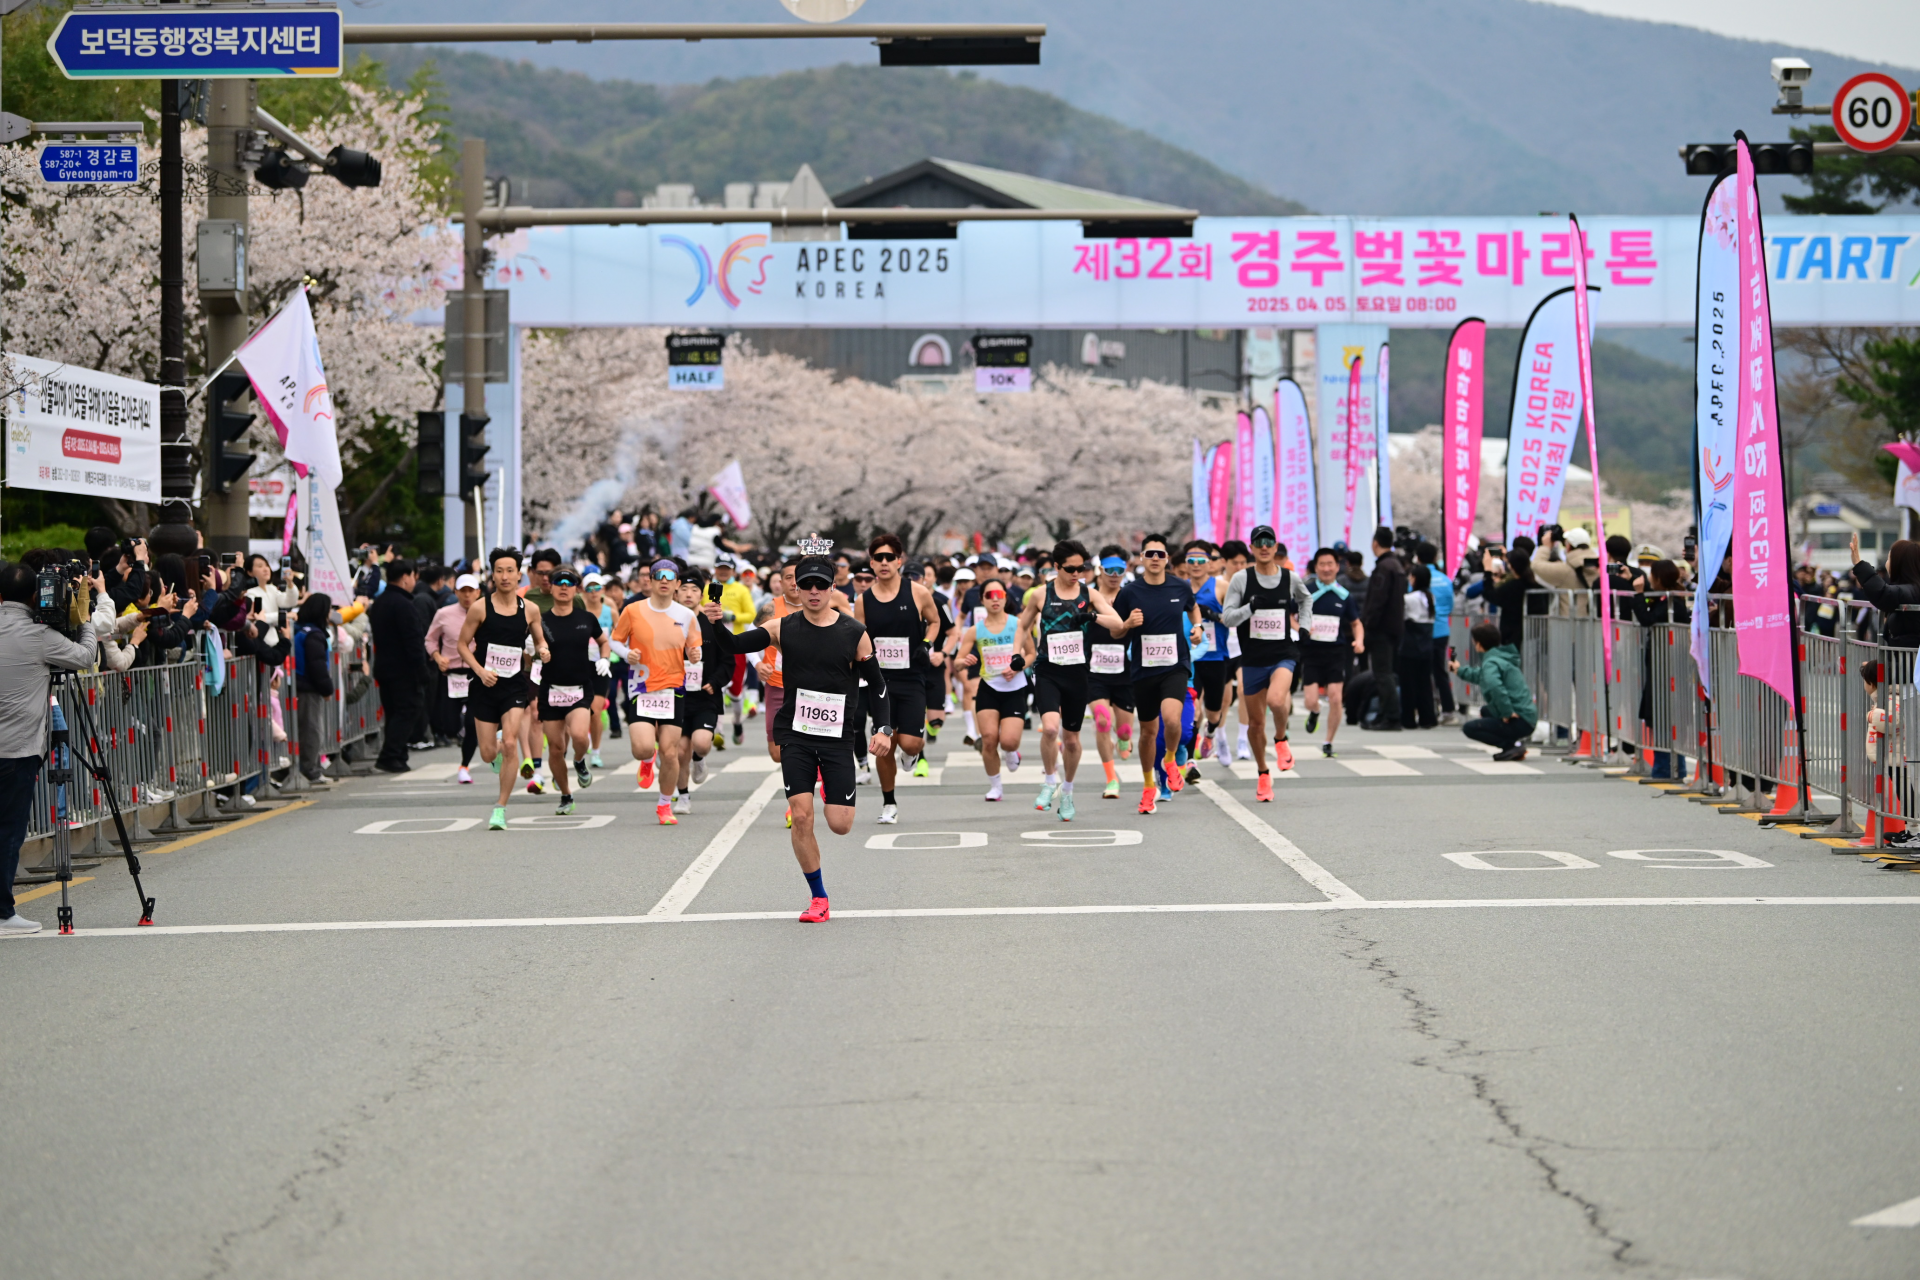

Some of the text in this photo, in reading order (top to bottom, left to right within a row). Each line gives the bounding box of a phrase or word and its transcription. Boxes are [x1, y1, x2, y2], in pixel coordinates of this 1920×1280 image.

[79, 26, 322, 56] 보덕동행정복지센터
[1848, 97, 1892, 128] 60
[59, 149, 82, 159] 587-1
[86, 149, 134, 166] 경감로
[44, 159, 74, 169] 587-20
[58, 167, 134, 181] Gyeonggam-ro
[796, 247, 950, 273] APEC 2025
[1071, 236, 1213, 283] 제32회
[1763, 235, 1912, 281] TART
[796, 281, 886, 298] KOREA
[1355, 297, 1402, 314] 토요일
[1406, 297, 1457, 313] 08:00
[1711, 291, 1725, 359] 2025
[676, 372, 715, 384] HALF
[990, 374, 1015, 386] 10K
[1525, 341, 1554, 429] KOREA
[40, 376, 67, 416] 산불피해
[68, 383, 87, 420] 이웃을
[88, 387, 101, 423] 위해
[102, 390, 120, 427] 마음을
[1550, 388, 1576, 434] 기원
[1518, 437, 1543, 504] 2025
[1544, 441, 1567, 487] 개최
[1253, 619, 1282, 630] 12592
[878, 648, 904, 659] 11331
[1052, 643, 1080, 655] 11998
[1145, 645, 1173, 656] 12776
[490, 655, 517, 667] 11667
[986, 654, 1013, 666] 22316
[640, 698, 671, 709] 12442
[800, 704, 838, 723] 11963
